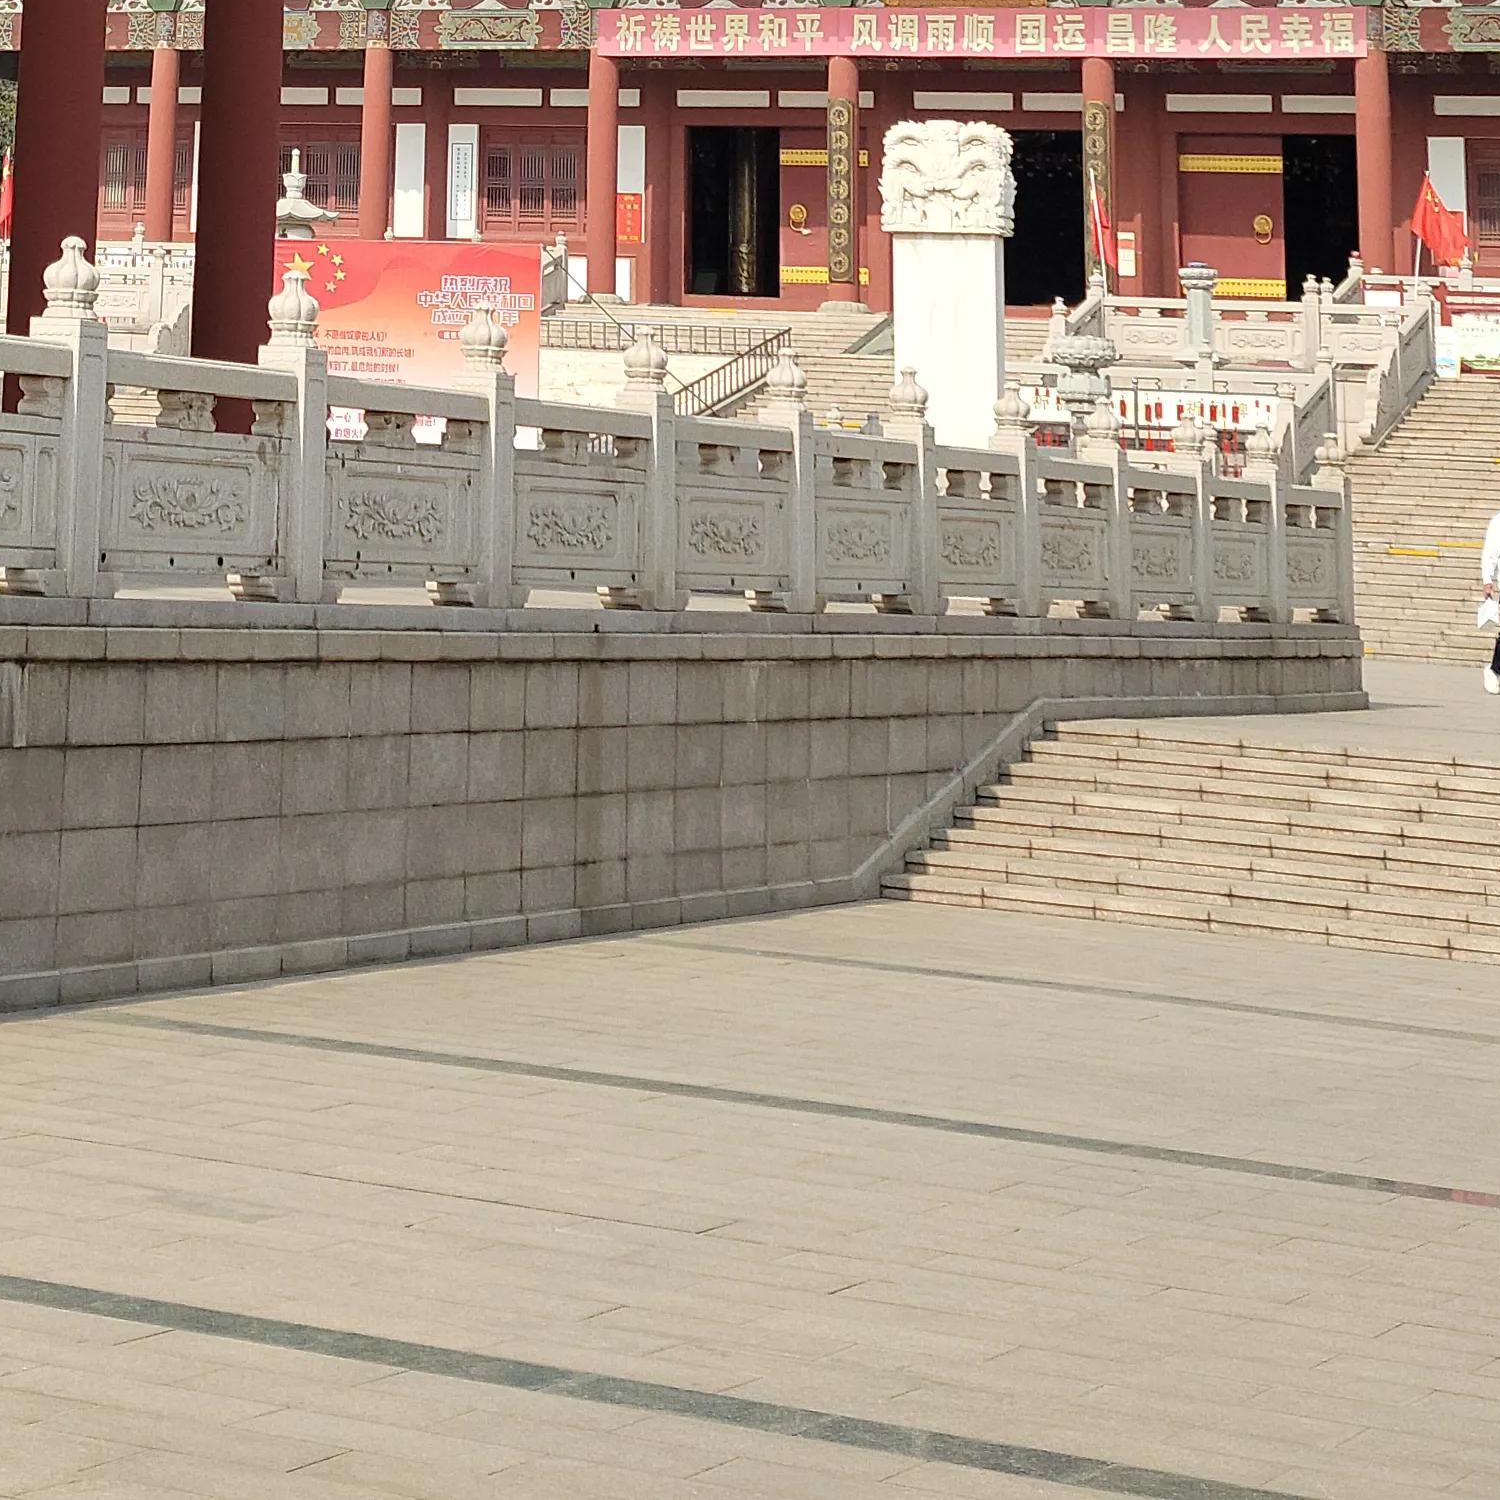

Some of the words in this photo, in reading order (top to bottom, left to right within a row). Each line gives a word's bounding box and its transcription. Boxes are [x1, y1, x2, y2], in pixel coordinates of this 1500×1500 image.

[615, 13, 825, 53] 祈祷世界和平
[851, 13, 996, 53] 风调雨顺
[1200, 13, 1356, 54] 人民幸福
[441, 275, 511, 294] 热烈庆祝
[417, 291, 536, 312] 中华人民共和国
